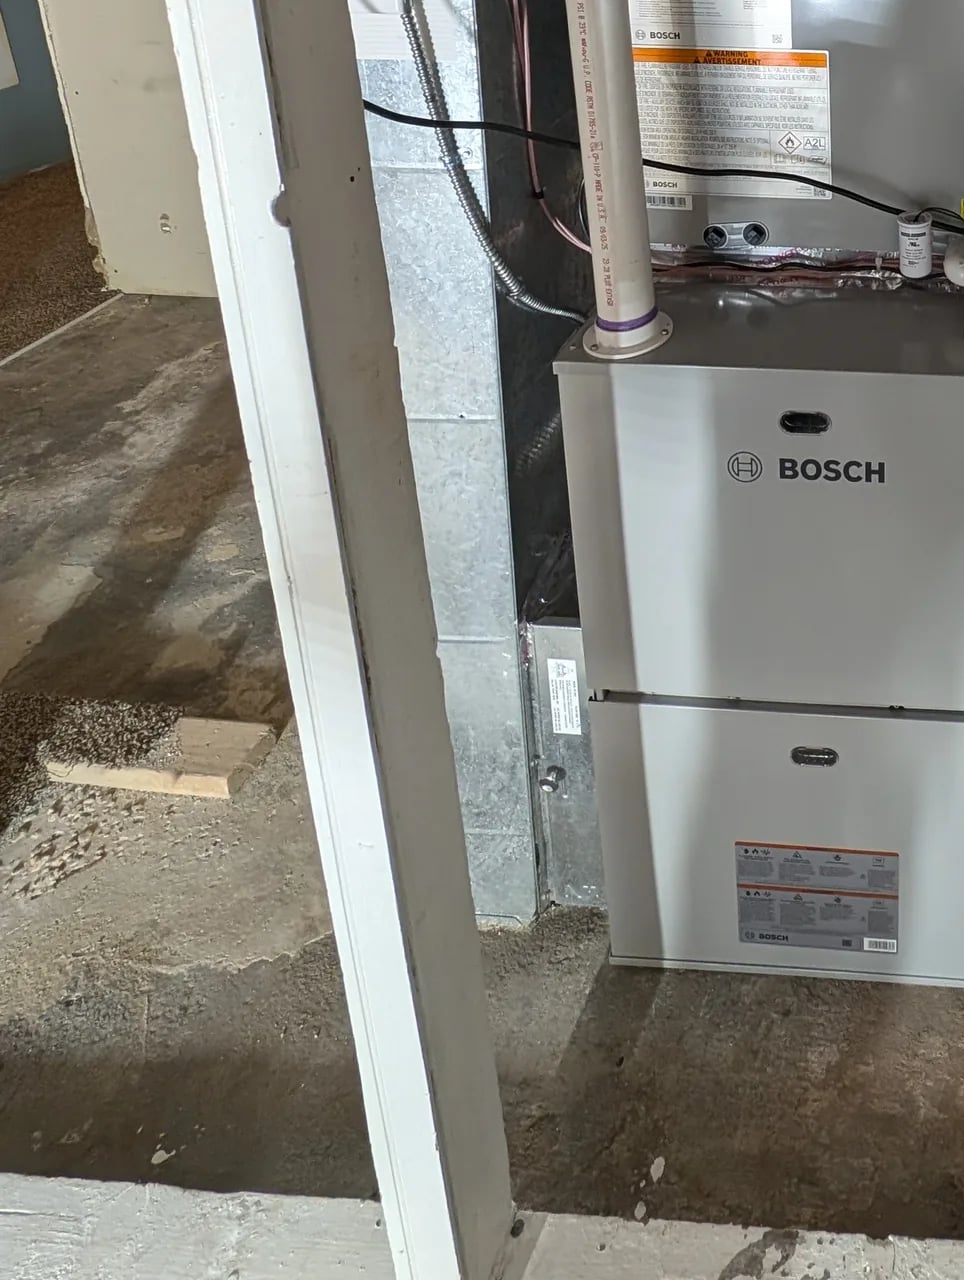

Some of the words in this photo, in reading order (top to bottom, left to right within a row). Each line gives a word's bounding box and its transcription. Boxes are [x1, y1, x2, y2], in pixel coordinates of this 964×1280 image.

[650, 31, 680, 40] BOSCH
[713, 50, 748, 58] WARNING
[703, 56, 761, 65] AVERTISSEMENT
[804, 138, 825, 150] A2L
[653, 181, 677, 189] BOSCH
[779, 458, 886, 484] BOSCH
[758, 932, 788, 942] BOSCH
